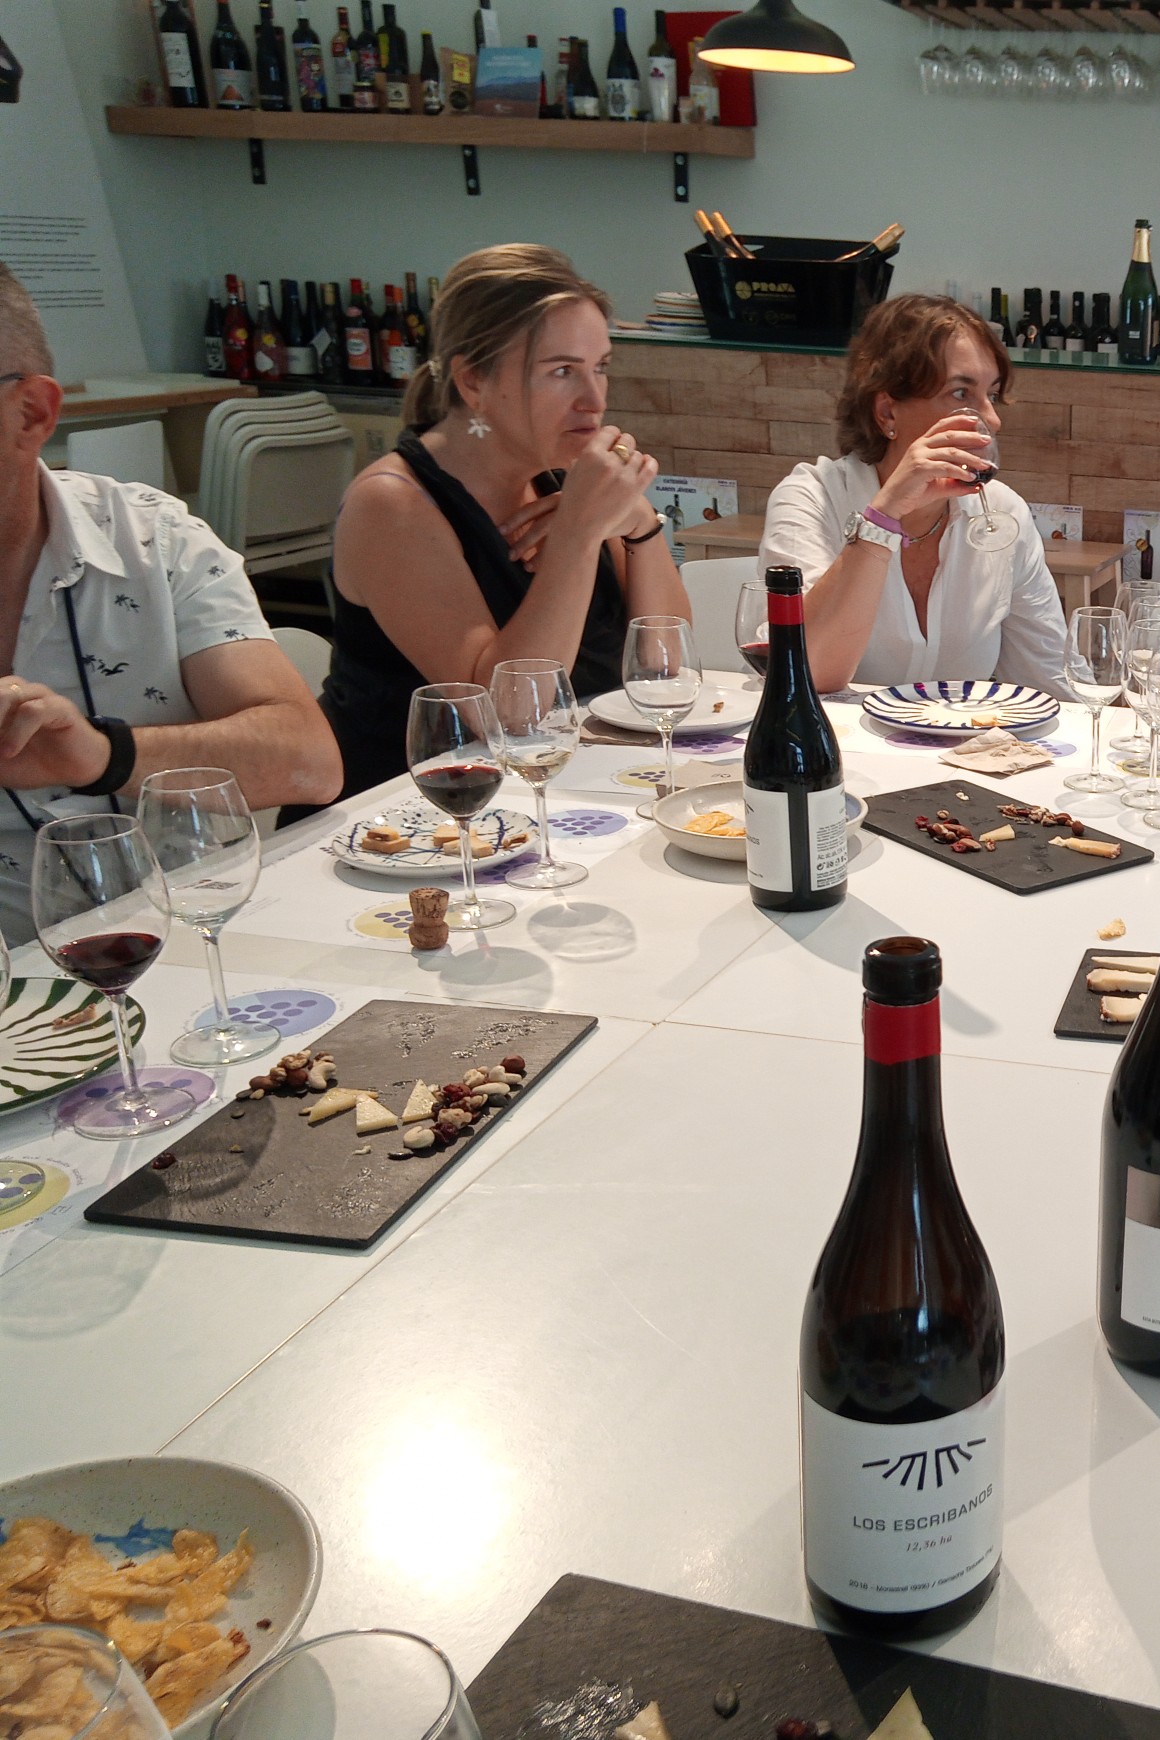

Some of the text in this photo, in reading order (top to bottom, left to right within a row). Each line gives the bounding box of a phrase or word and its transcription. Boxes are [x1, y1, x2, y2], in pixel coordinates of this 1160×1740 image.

[752, 281, 795, 293] PROAVA
[852, 1483, 994, 1532] LOS ESCRIBANOS
[905, 1533, 953, 1553] 12,36 ha
